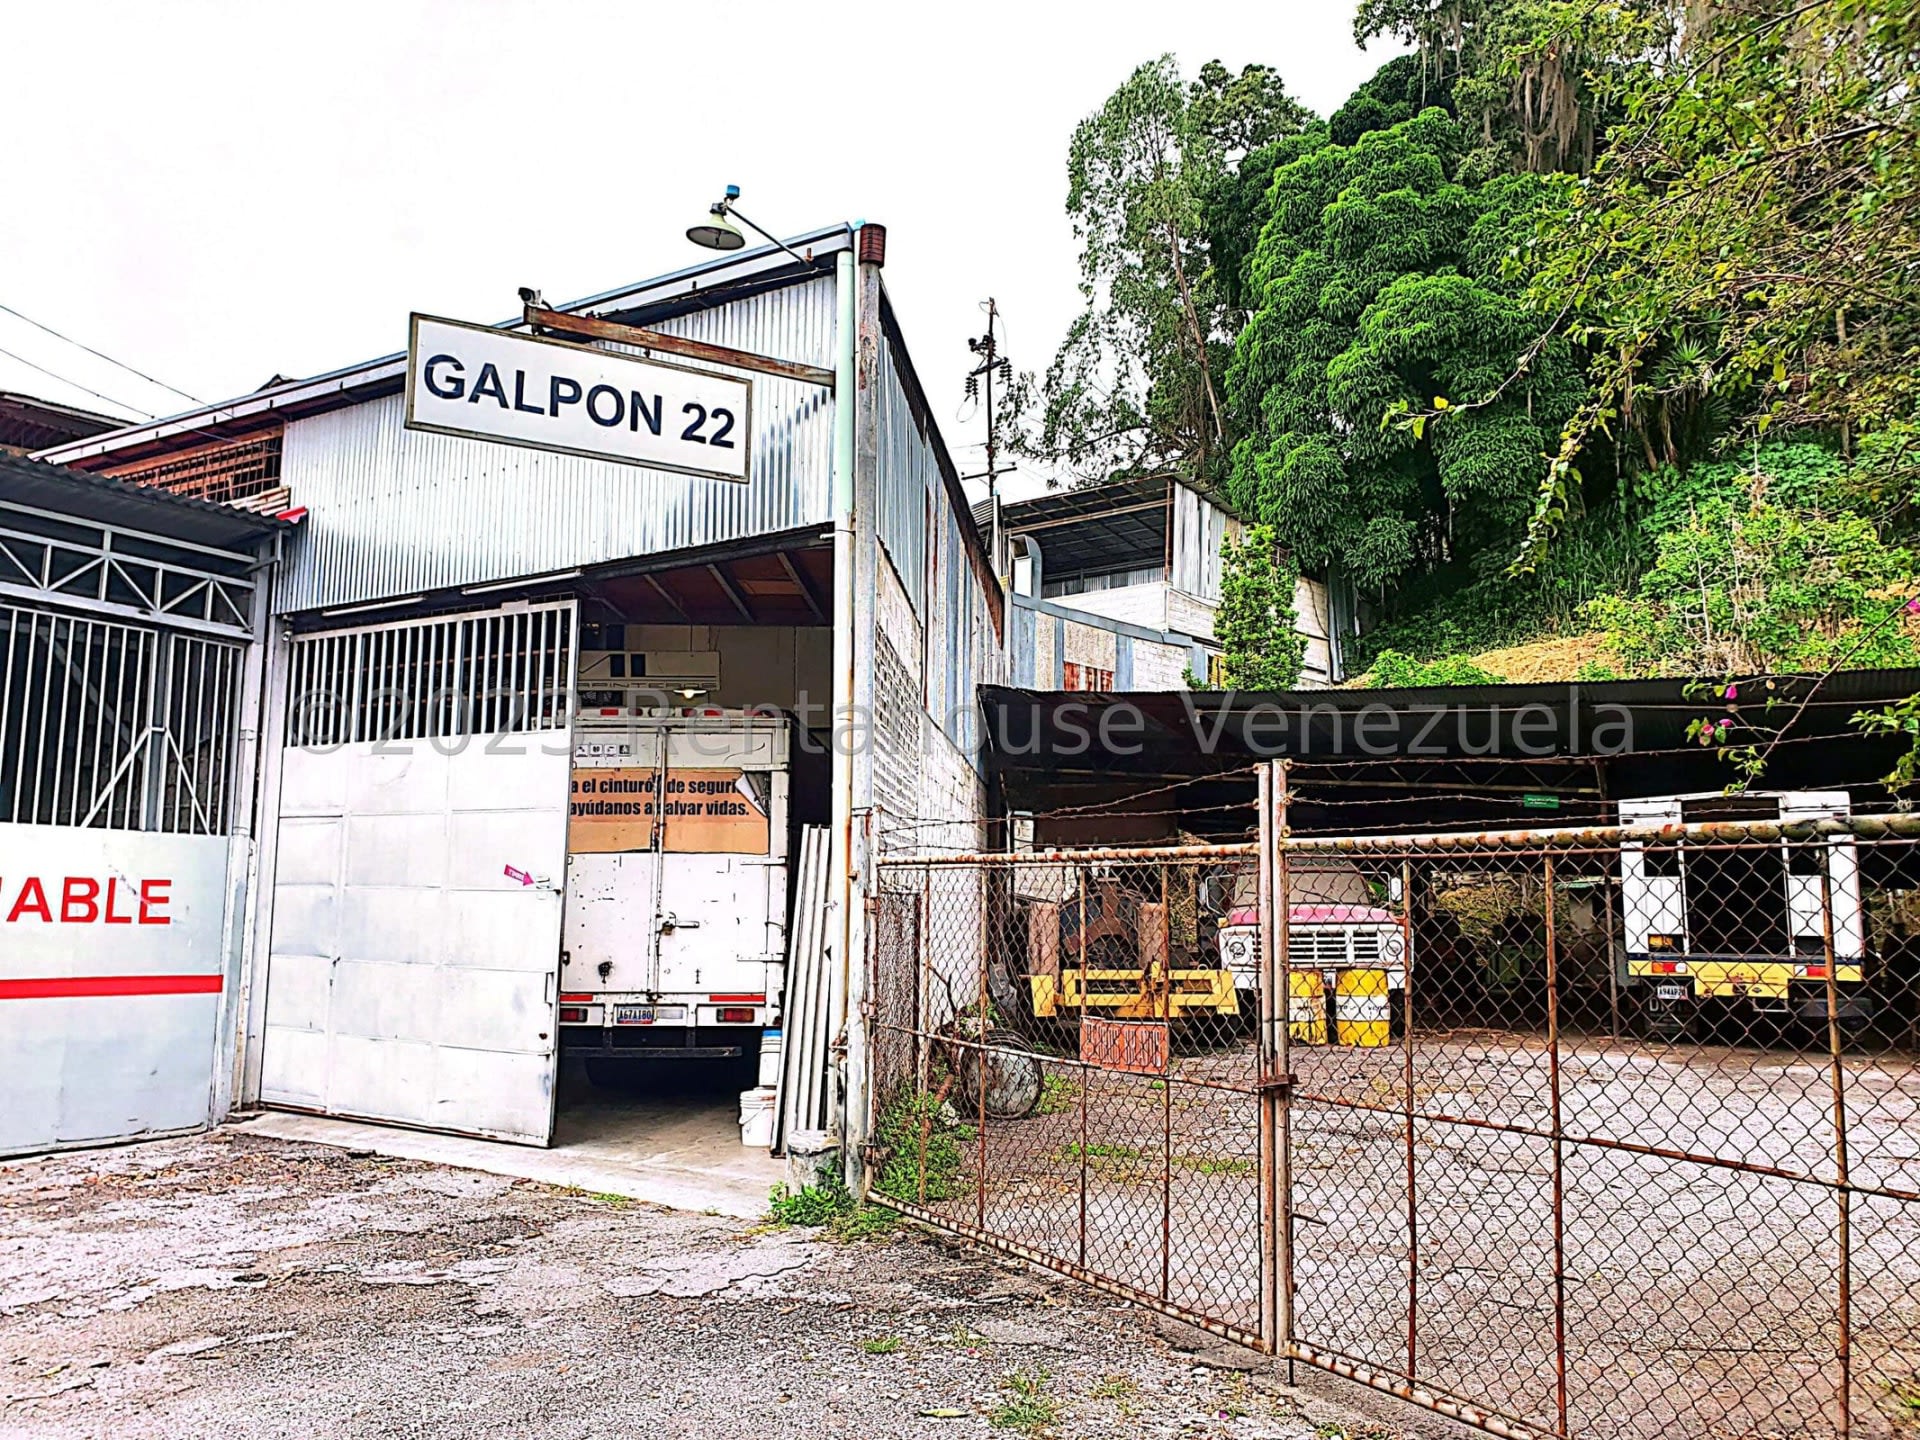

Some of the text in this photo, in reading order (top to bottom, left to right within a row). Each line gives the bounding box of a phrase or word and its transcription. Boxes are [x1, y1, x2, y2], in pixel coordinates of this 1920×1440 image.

[423, 354, 735, 449] GALPON 22
[582, 778, 596, 793] el
[667, 778, 685, 793] de
[570, 800, 749, 817] ayúdanos a alvar vidas.
[0, 876, 172, 924] ABLE
